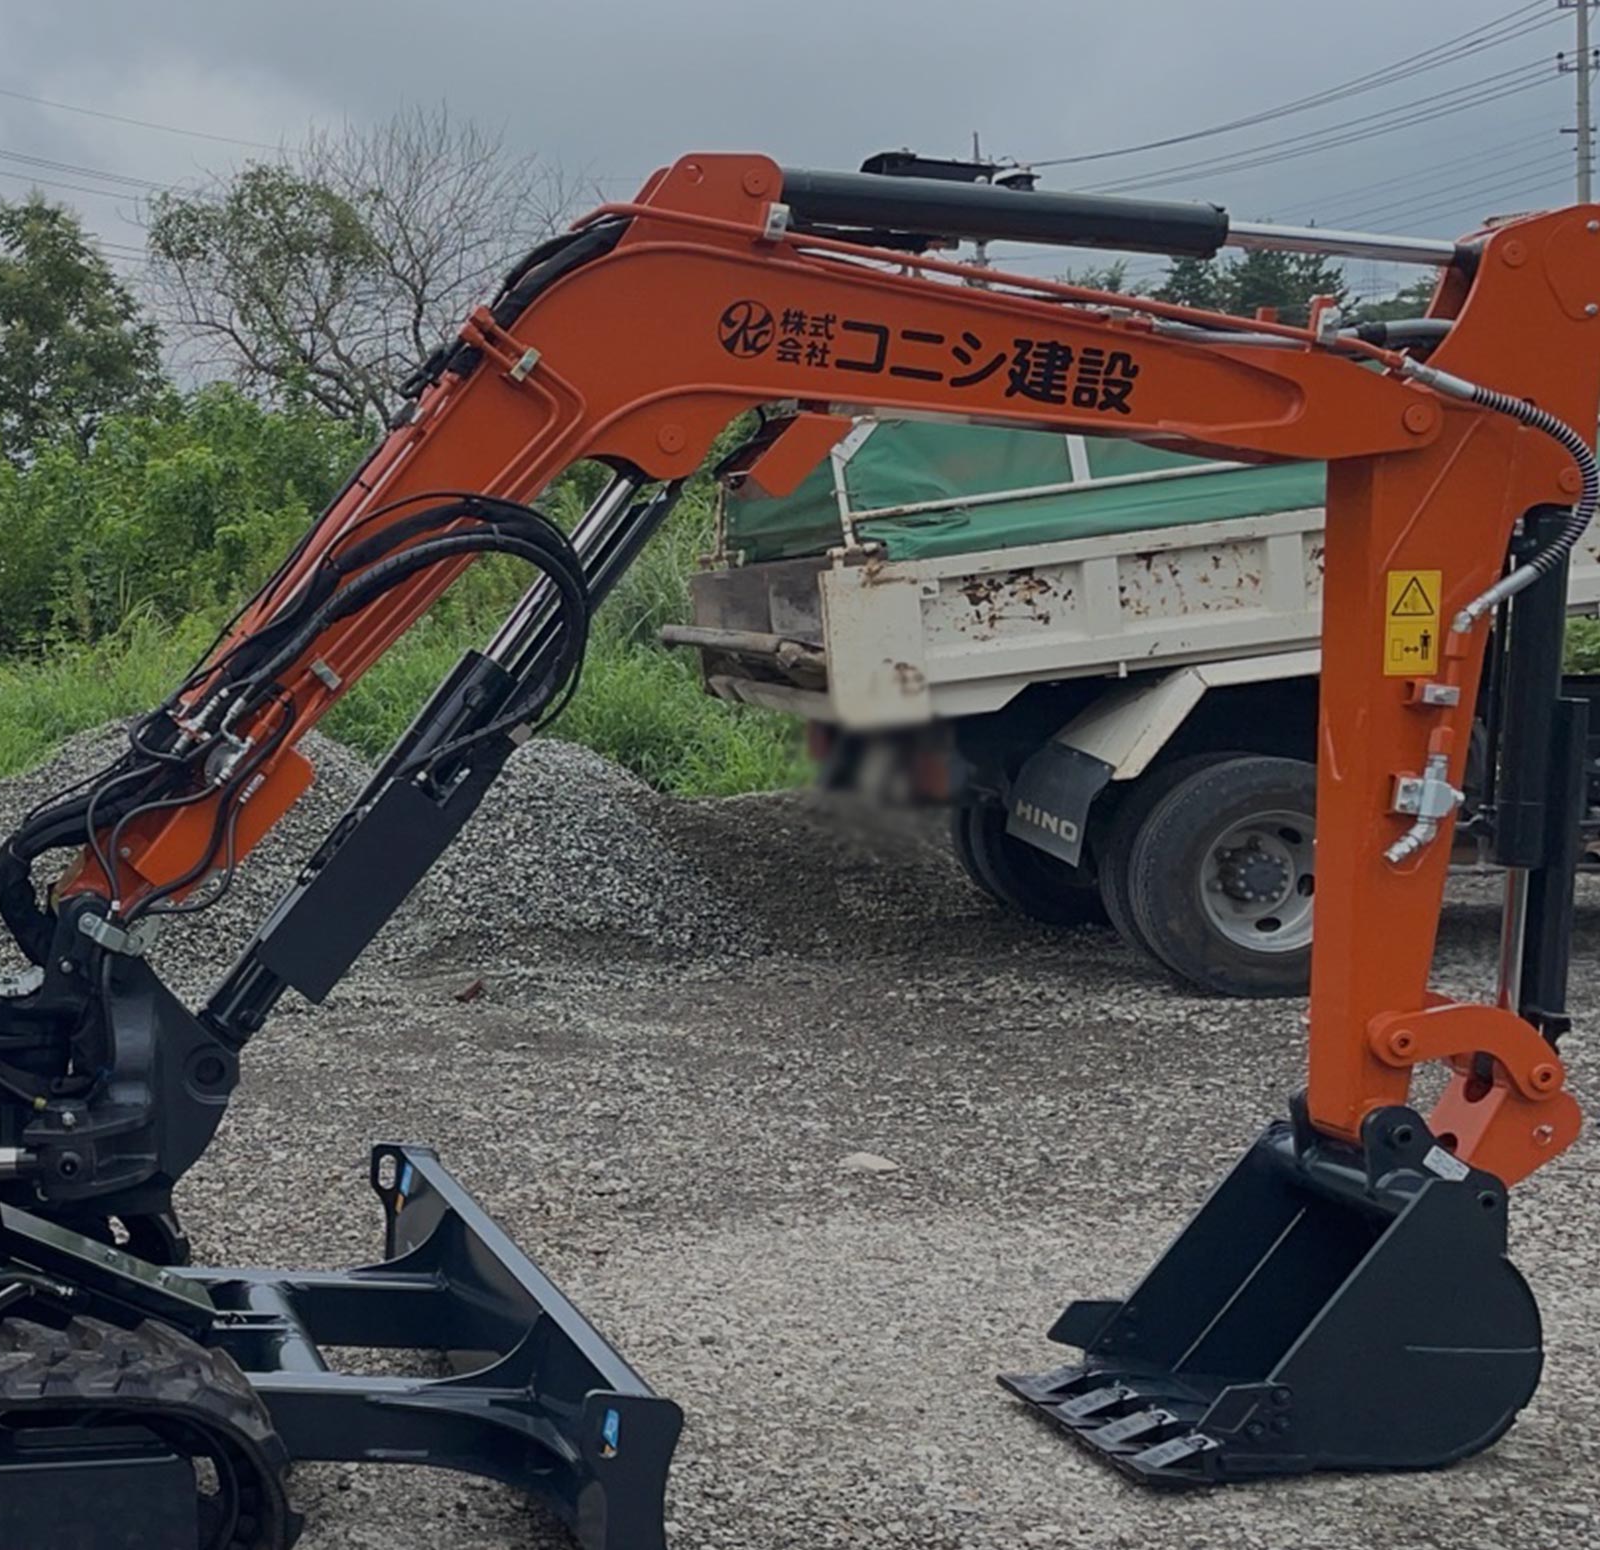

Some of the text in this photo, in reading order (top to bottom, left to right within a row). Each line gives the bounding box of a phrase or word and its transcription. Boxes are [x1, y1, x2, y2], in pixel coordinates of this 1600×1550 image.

[780, 307, 836, 340] 株式
[776, 337, 831, 368] 会社
[835, 319, 1140, 414] コニシ建設
[1016, 799, 1078, 842] HINO
